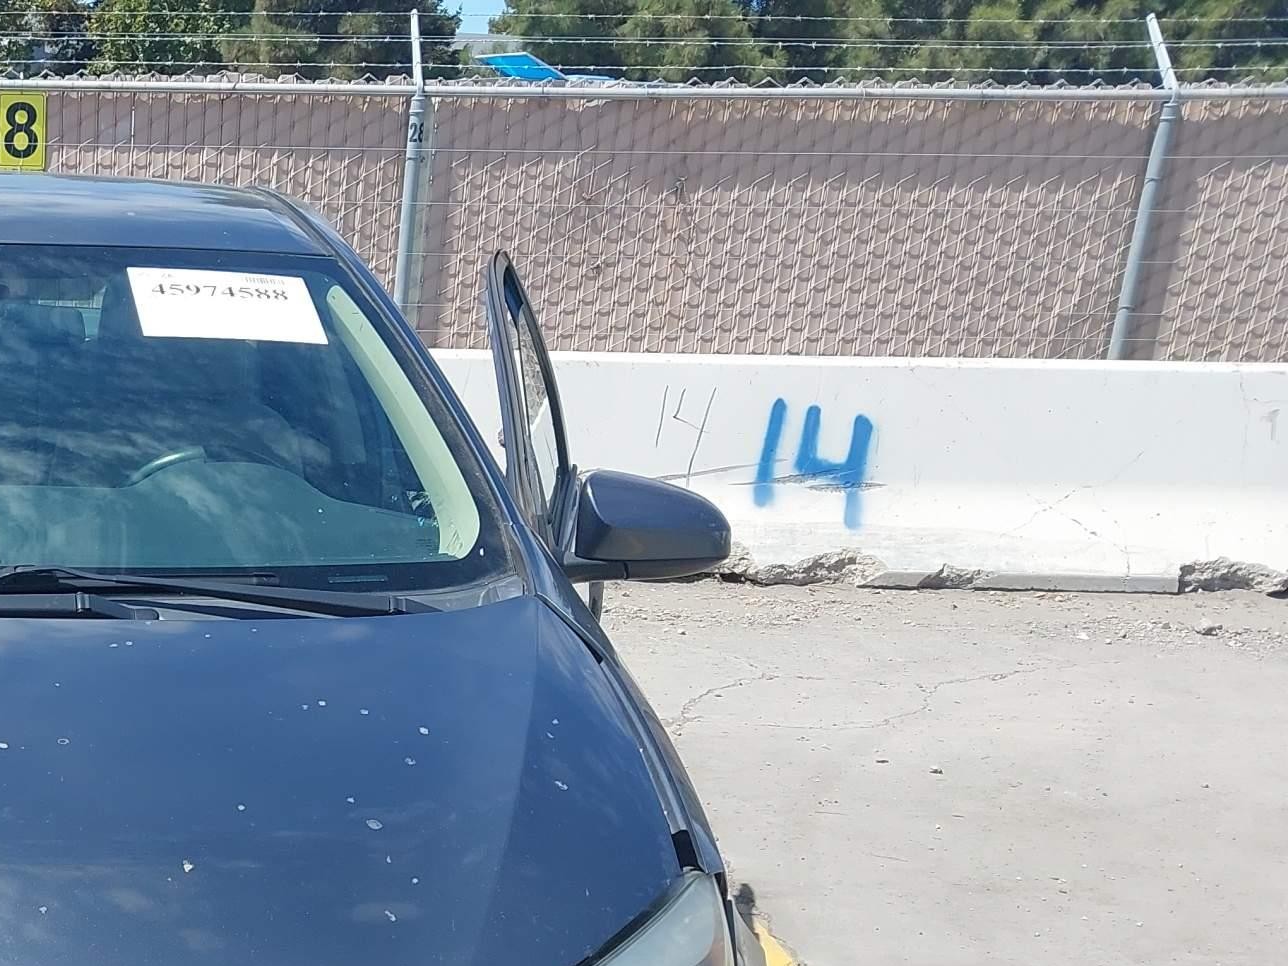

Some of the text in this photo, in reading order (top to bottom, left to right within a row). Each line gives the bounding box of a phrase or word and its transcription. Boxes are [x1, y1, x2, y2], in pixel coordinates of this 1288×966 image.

[4, 102, 39, 159] 8
[151, 282, 290, 301] 45974588
[753, 398, 873, 529] 14
